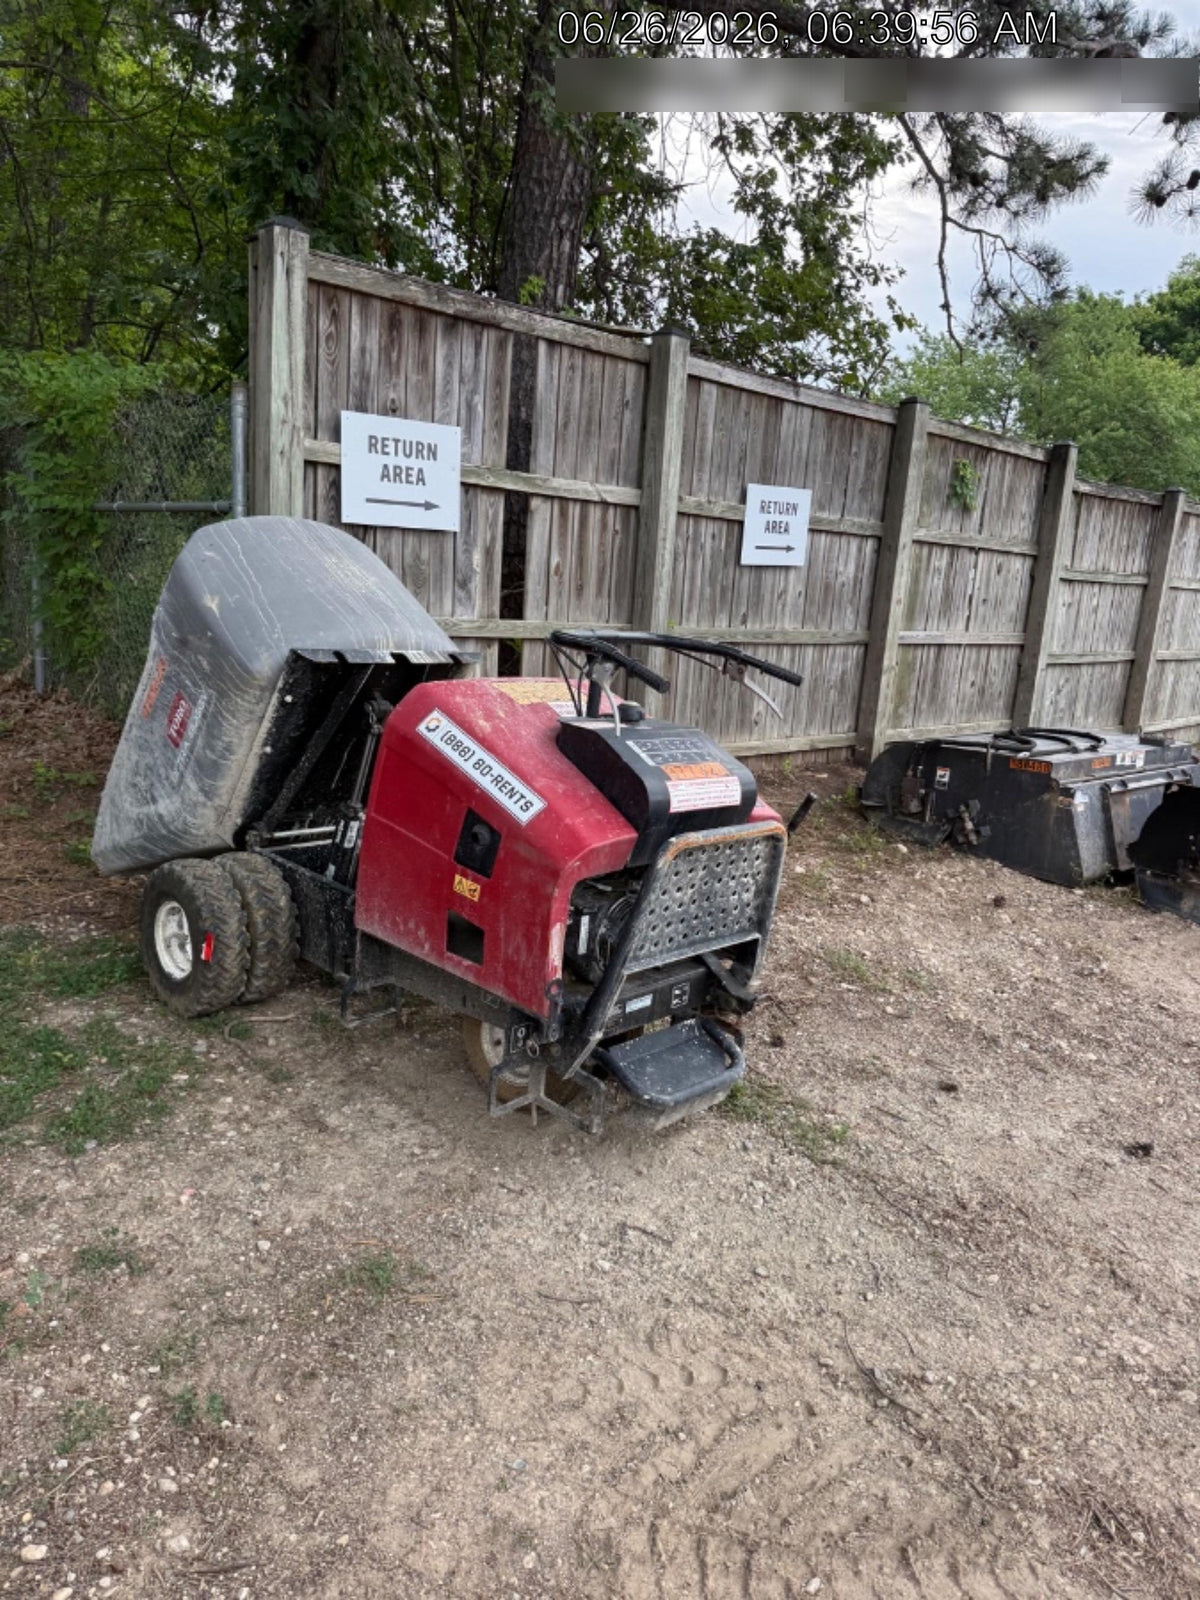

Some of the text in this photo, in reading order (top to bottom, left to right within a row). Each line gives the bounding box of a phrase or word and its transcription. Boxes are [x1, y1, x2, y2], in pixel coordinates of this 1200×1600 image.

[368, 435, 438, 462] RETURN
[380, 463, 426, 487] AREA
[759, 500, 799, 516] RETURN
[764, 520, 790, 535] AREA
[440, 730, 534, 813] (888) 80-RENTS
